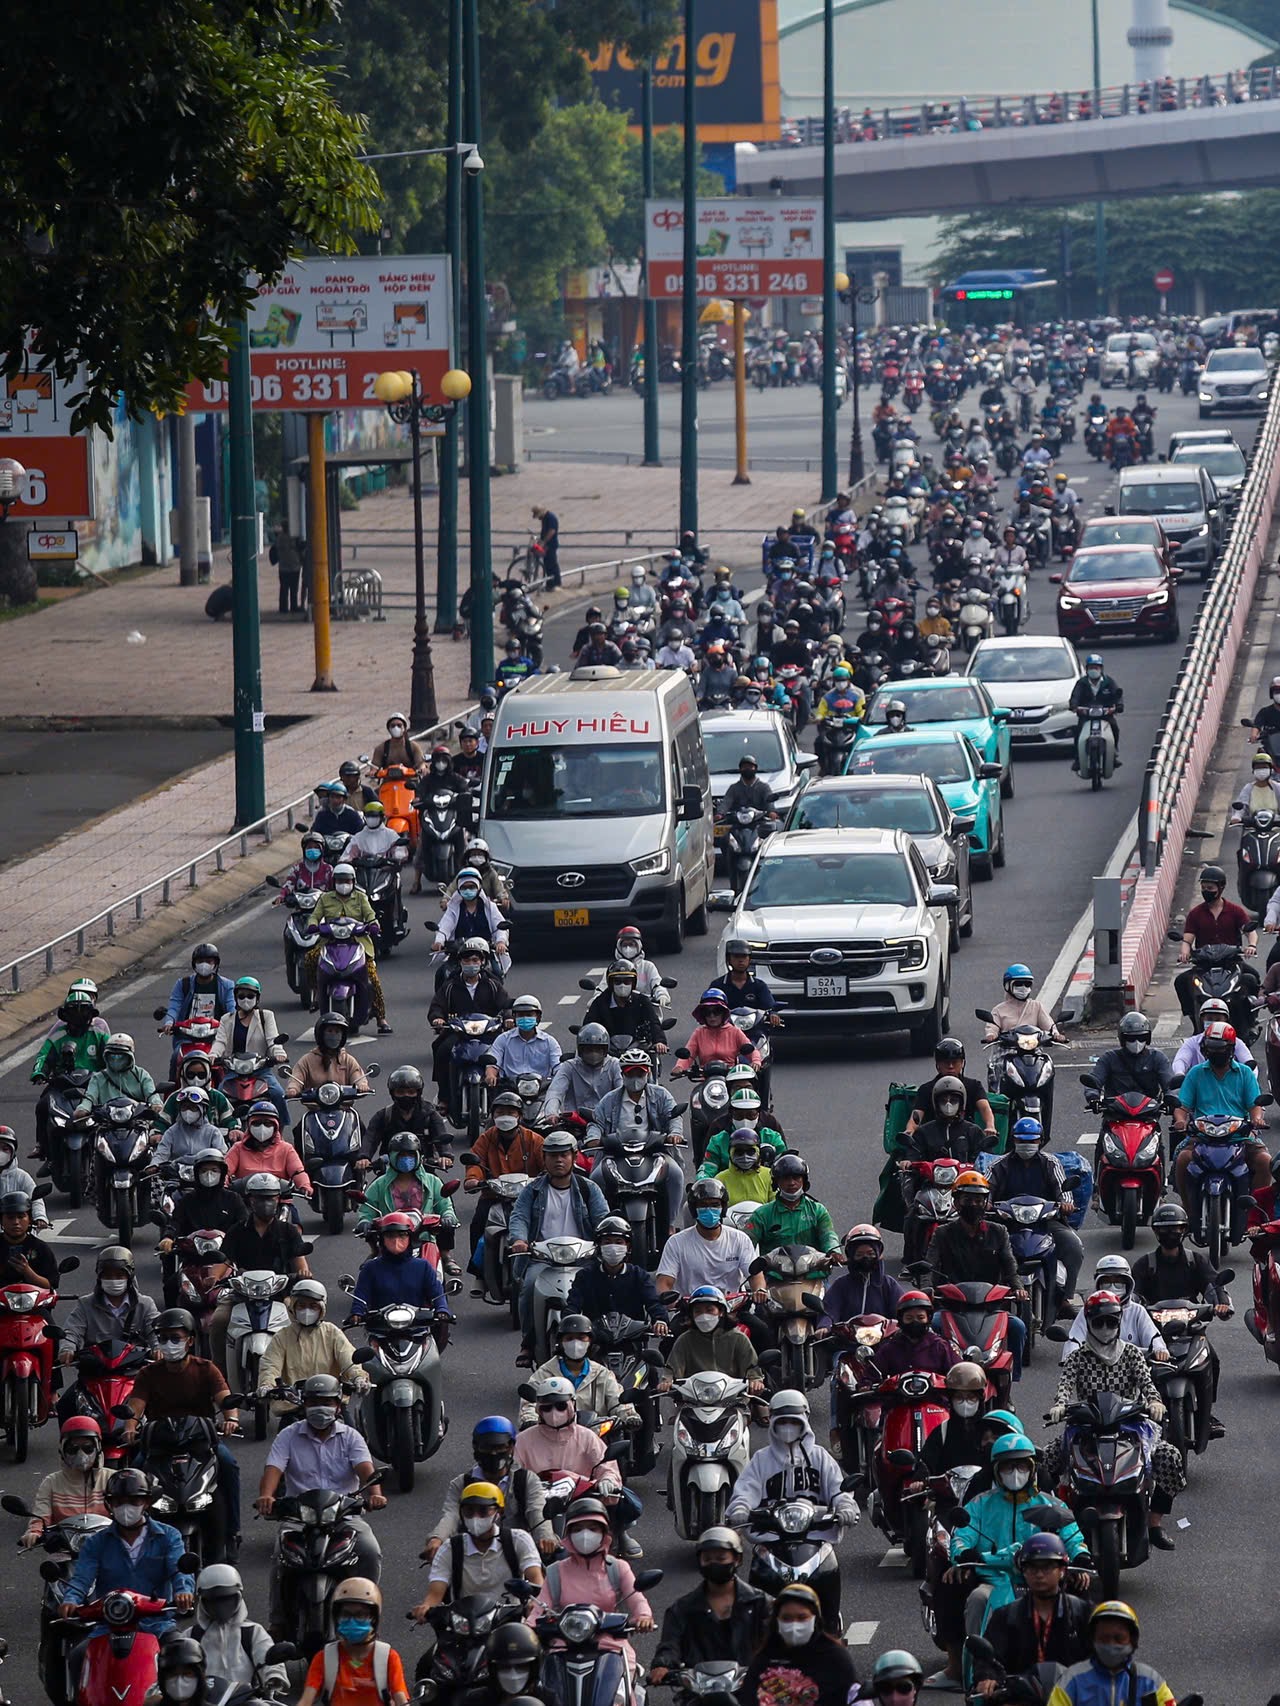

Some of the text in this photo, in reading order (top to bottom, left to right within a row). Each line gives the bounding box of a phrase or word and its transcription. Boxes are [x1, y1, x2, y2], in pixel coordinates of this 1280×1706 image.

[325, 276, 355, 284] PANO
[723, 274, 761, 292] 331
[769, 273, 808, 291] 246
[310, 284, 344, 294] NGOÀI
[384, 283, 406, 294] HỘP
[276, 357, 346, 371] HOTLINE:
[293, 373, 349, 401] 331
[506, 719, 570, 740] HUY
[818, 978, 836, 987] 62A
[811, 986, 842, 996] 339.17
